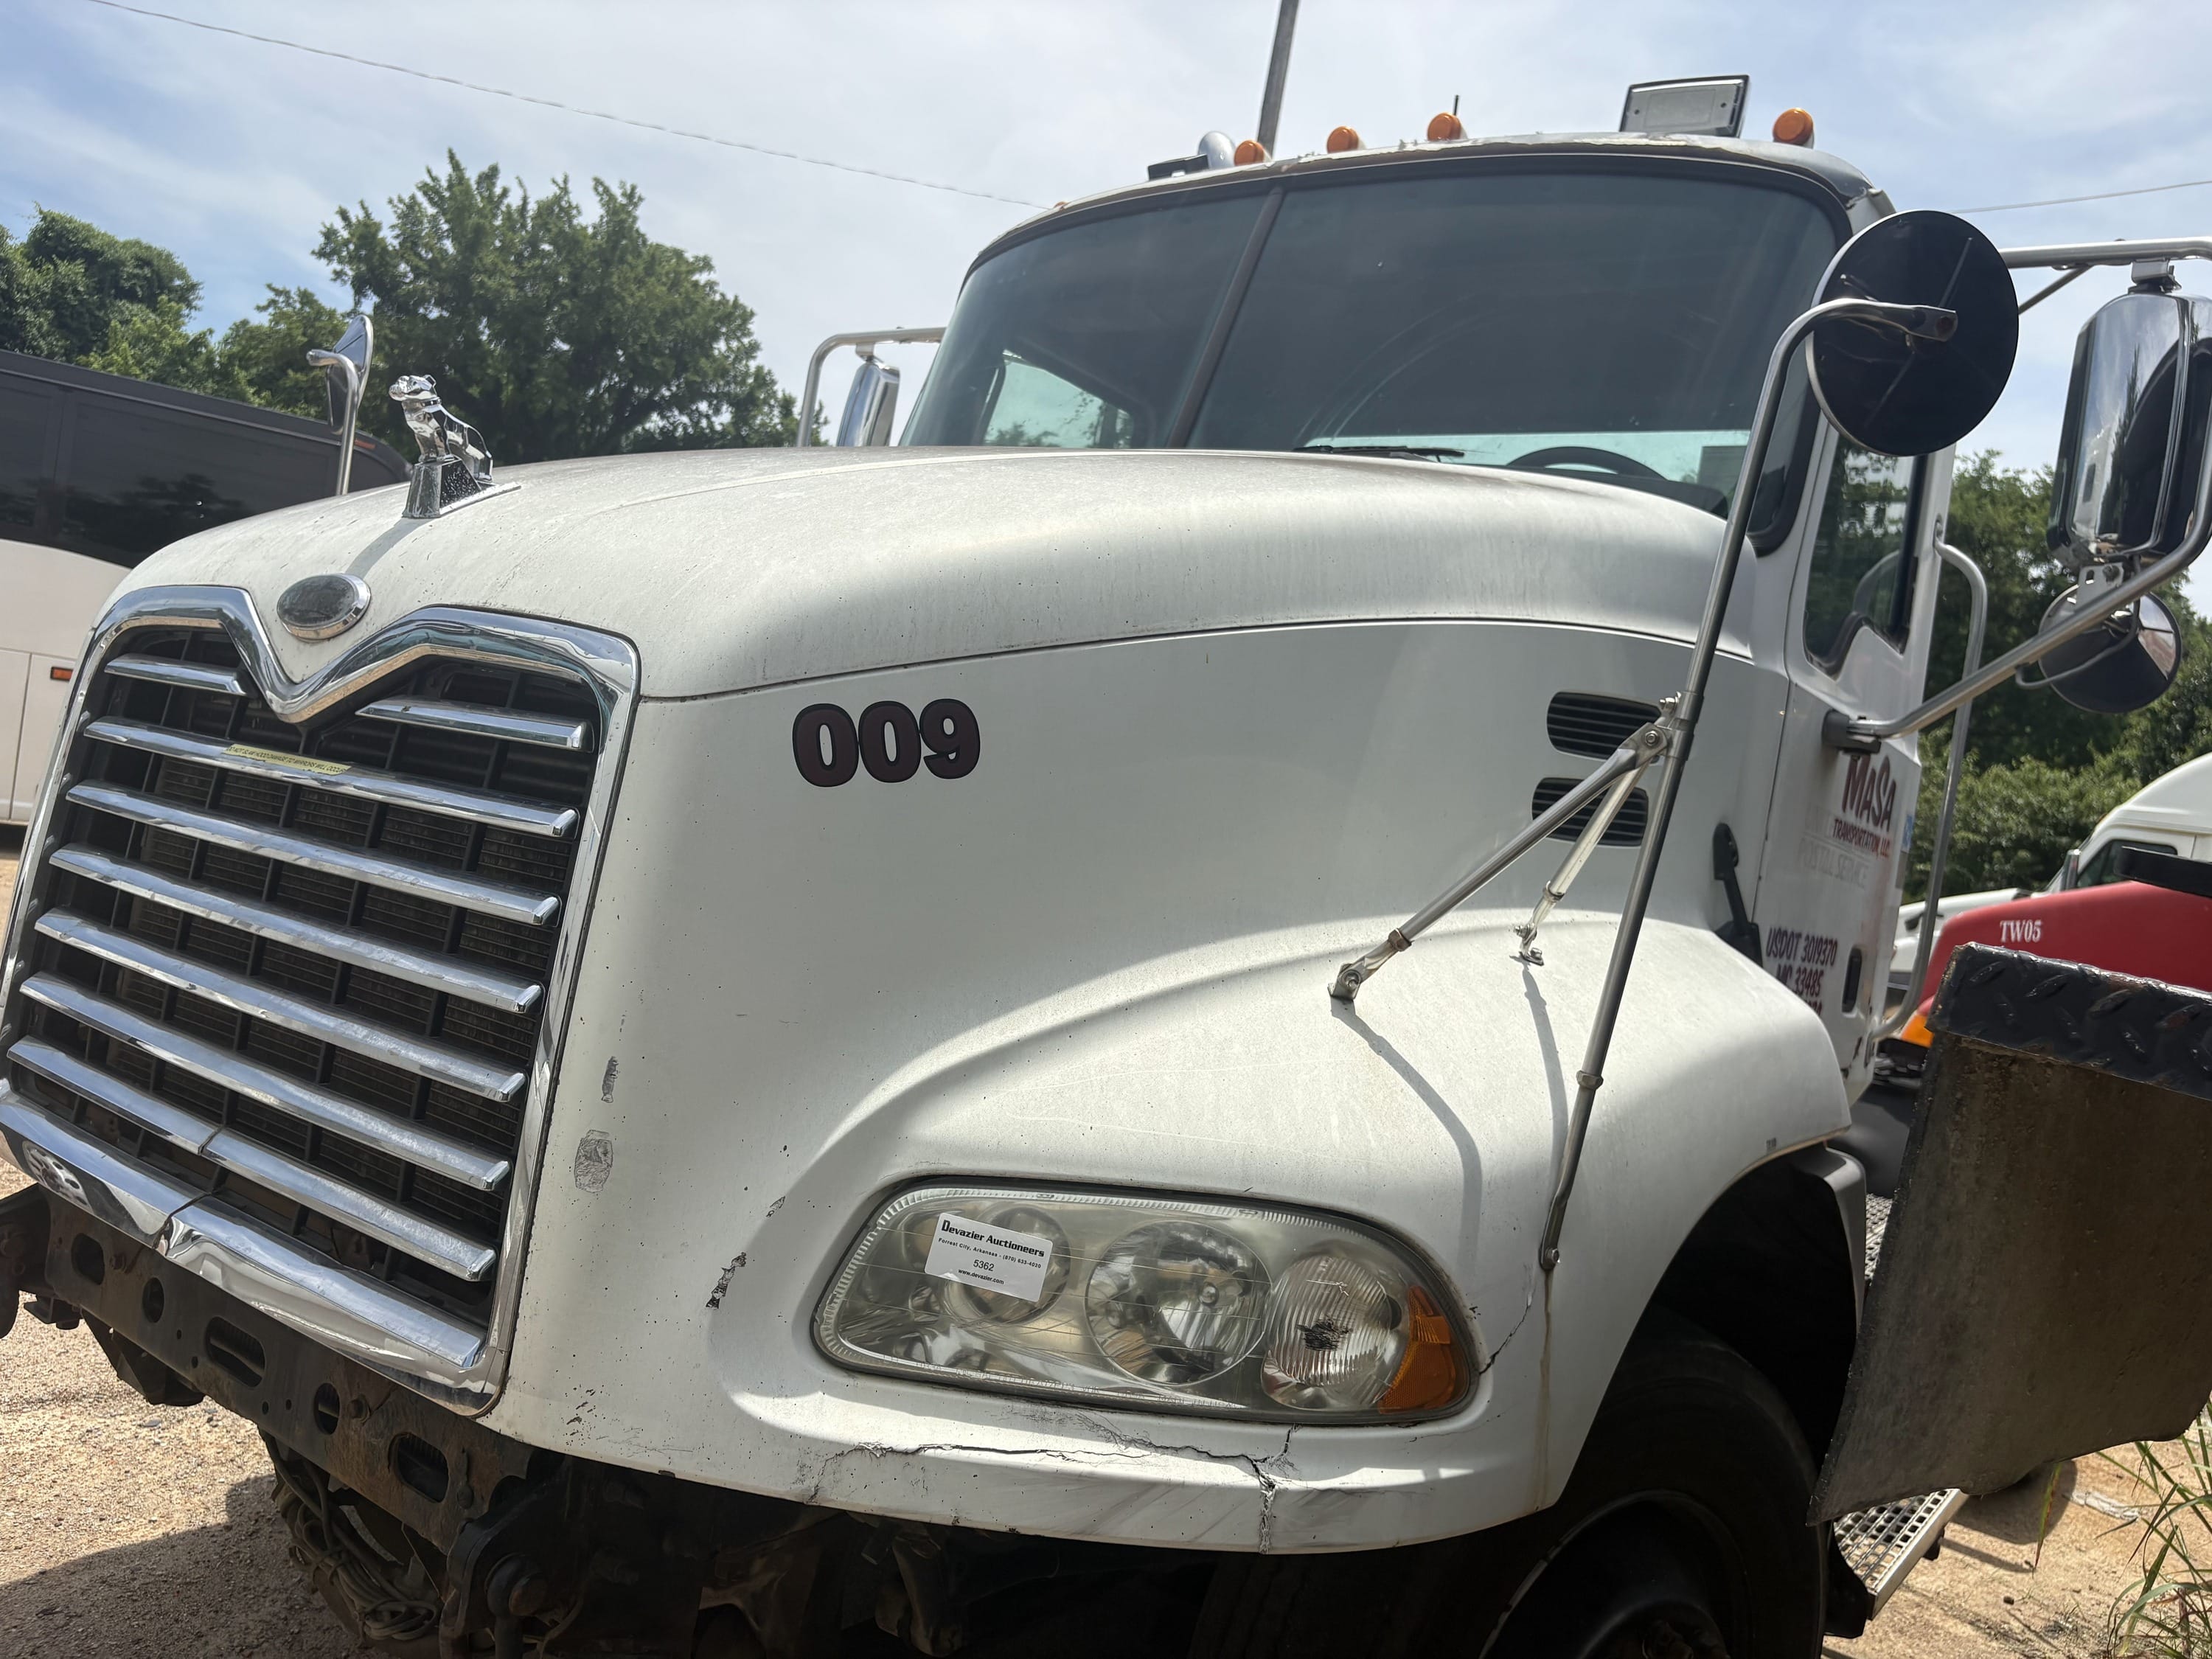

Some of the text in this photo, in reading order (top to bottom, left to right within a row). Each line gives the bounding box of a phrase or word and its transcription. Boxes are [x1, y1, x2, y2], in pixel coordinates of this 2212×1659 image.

[792, 698, 981, 787] 009
[1842, 755, 1896, 832] MASA
[1766, 927, 1837, 967] USDOT 3019370
[2000, 919, 2042, 942] TW05
[938, 1237, 958, 1247] Forrest
[959, 1243, 972, 1251] City,
[973, 1247, 998, 1257] Arkansas
[1002, 1254, 1017, 1263] (870)
[1017, 1258, 1042, 1269] 633-4020
[941, 1220, 1045, 1257] Devazier Auctioneers
[958, 1269, 1004, 1284] www.devazier.com
[973, 1259, 995, 1272] 5362
